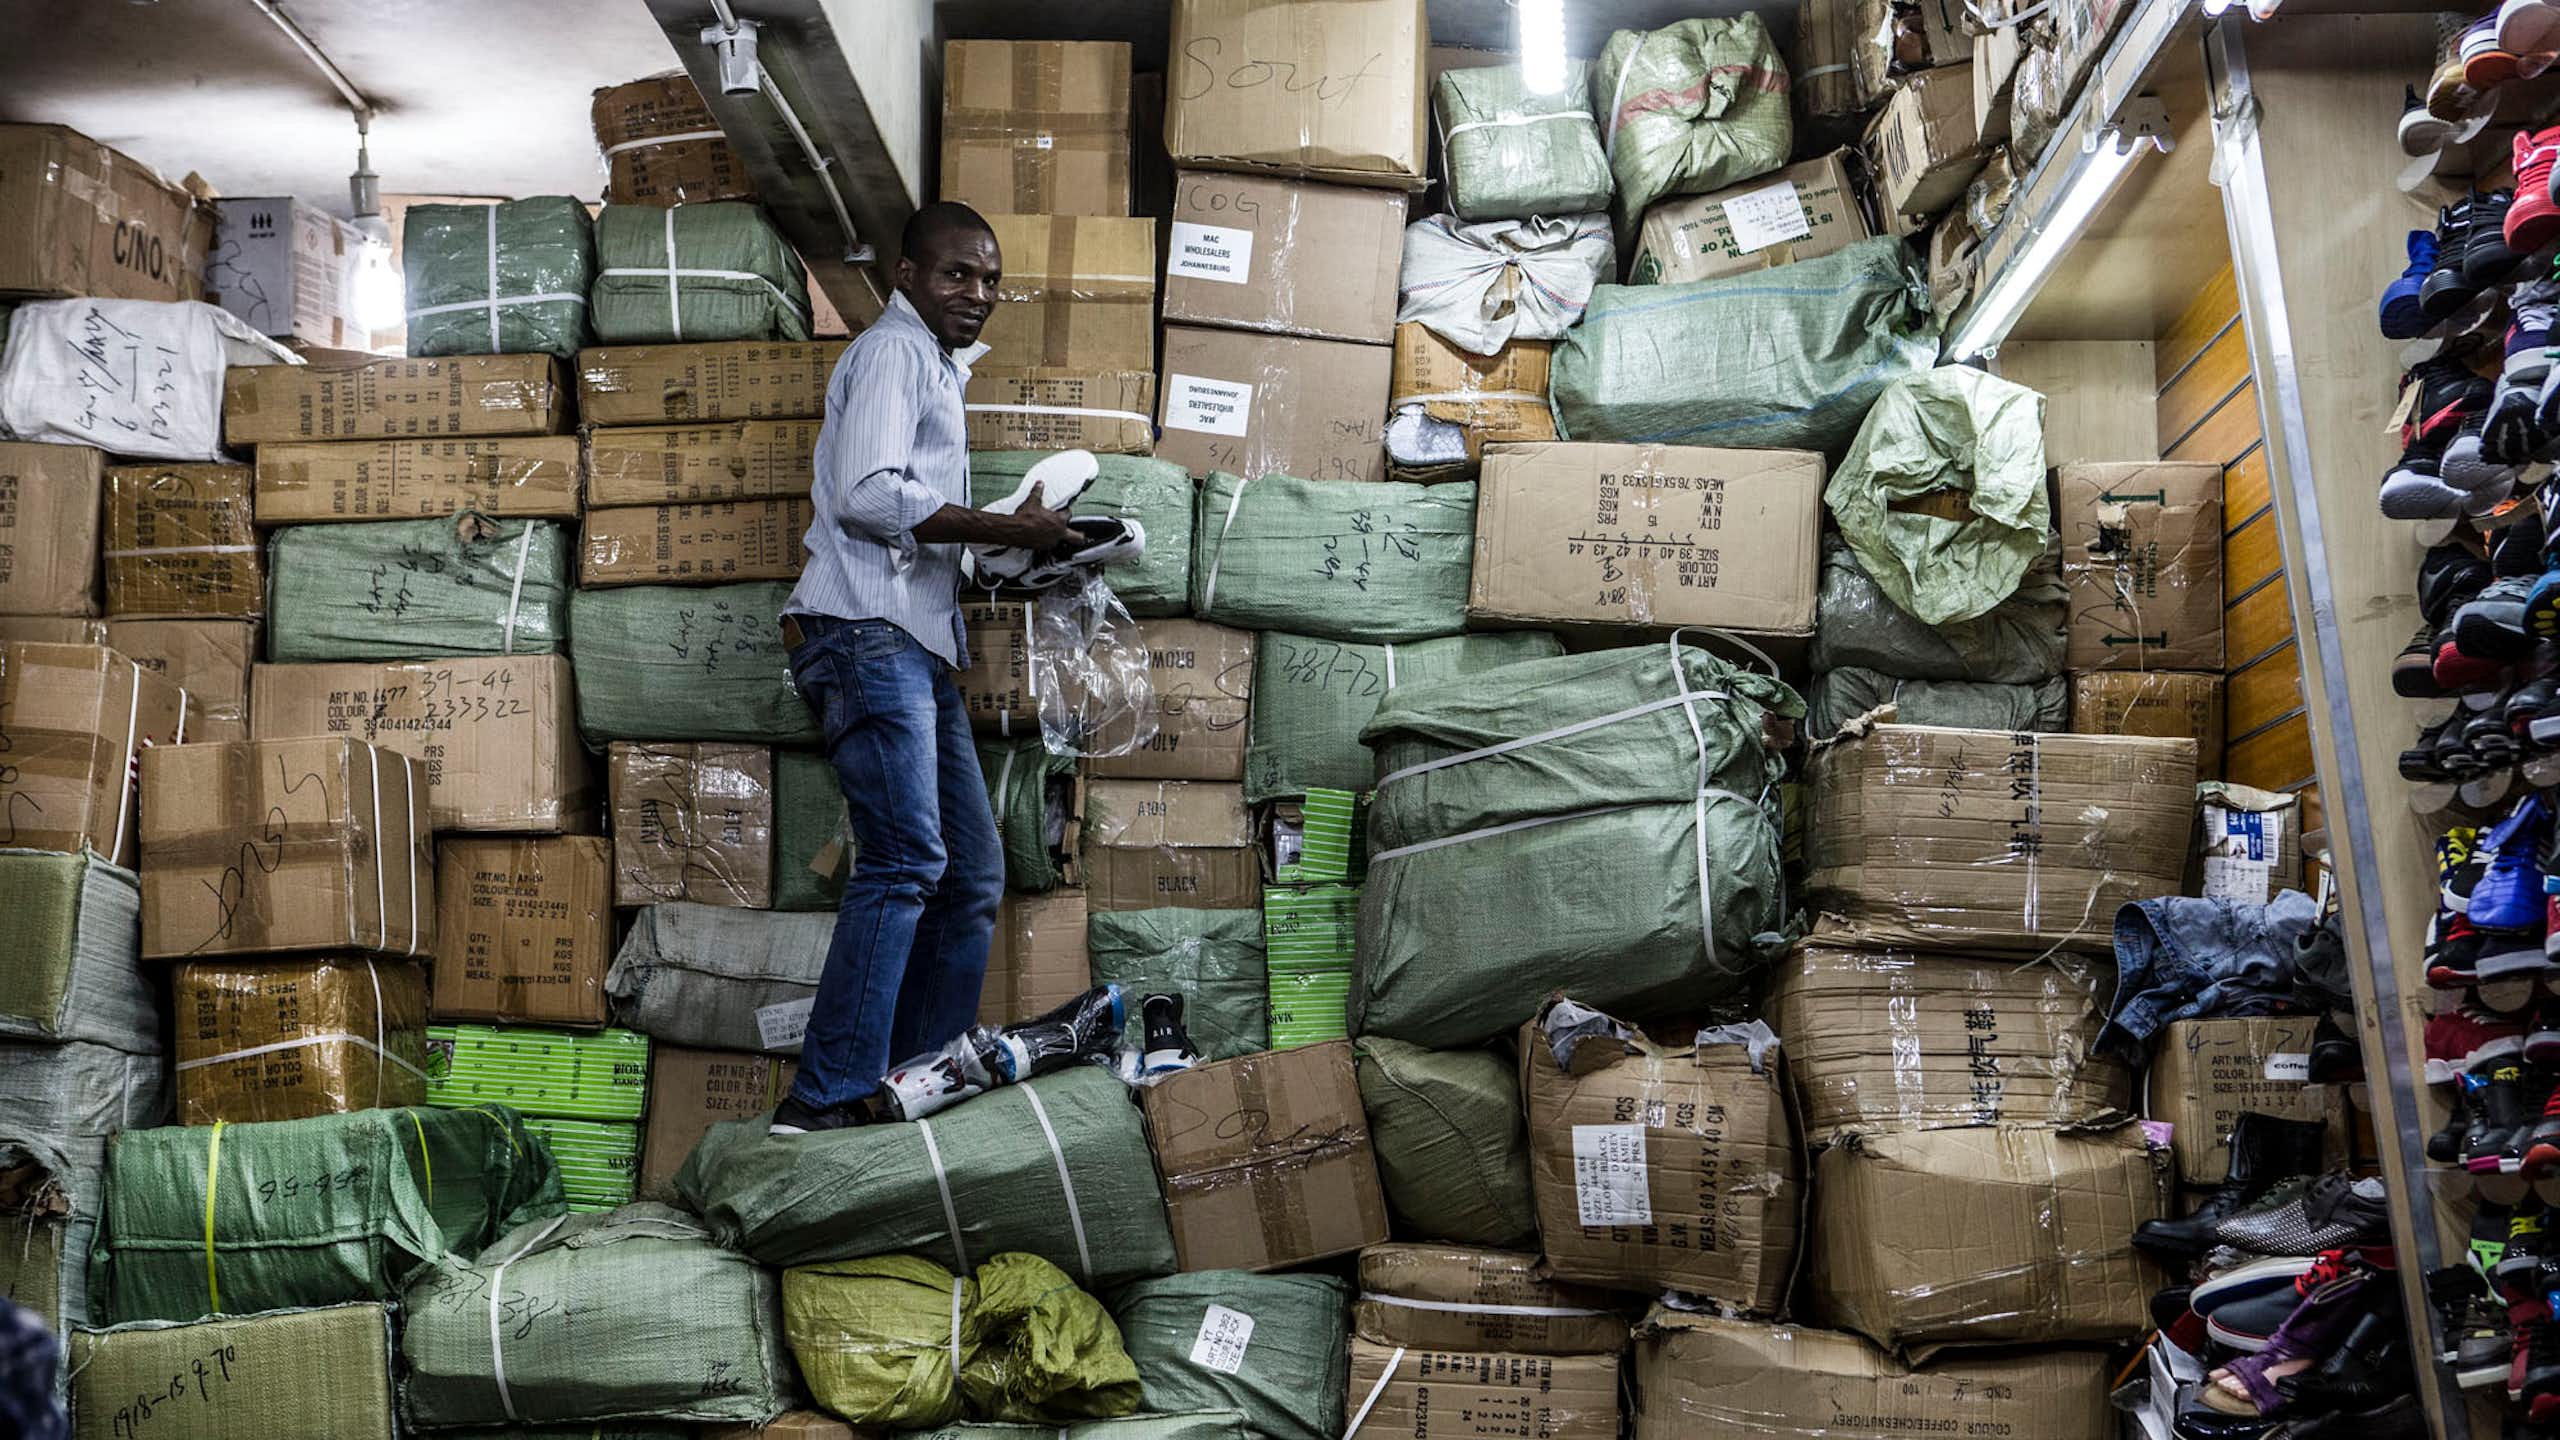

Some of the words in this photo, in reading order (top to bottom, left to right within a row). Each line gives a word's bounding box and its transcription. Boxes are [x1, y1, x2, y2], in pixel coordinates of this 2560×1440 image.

[1202, 234, 1220, 245] MAC
[1184, 244, 1231, 259] WHOLESALERS
[1180, 259, 1231, 273] JOHANNESBURG
[1188, 385, 1240, 400] JOHANNESBURG
[1188, 400, 1235, 414] WHOLESALERS
[1199, 414, 1217, 425] MAC
[1599, 473, 1616, 486] CM
[1598, 486, 1620, 499] KGS
[1598, 499, 1619, 512] KGS
[1597, 512, 1618, 526] PRS
[1648, 515, 1658, 527] 15
[1568, 542, 1586, 555] 44
[1593, 543, 1609, 557] 43
[1616, 543, 1632, 558] 42
[1638, 545, 1653, 559] 41
[1659, 546, 1676, 560] 40
[1679, 547, 1694, 560] 39
[329, 691, 351, 704] ART
[424, 745, 445, 758] PRS
[427, 759, 443, 773] GS
[427, 773, 442, 786] GS
[1137, 801, 1166, 817] A109
[1156, 876, 1199, 893] BLACK
[555, 937, 575, 948] PRS
[553, 949, 574, 960] KGS
[552, 962, 572, 972] KGS
[1152, 1026, 1173, 1039] AIR
[1612, 1097, 1637, 1123] PCS
[1673, 1103, 1697, 1129] KGS
[1706, 1106, 1726, 1126] CM
[1704, 1129, 1722, 1145] 40
[1598, 1136, 1609, 1172] BLACK
[1620, 1136, 1631, 1173] CAMEL
[1631, 1141, 1641, 1163] PRS
[1702, 1147, 1721, 1157] X
[1700, 1160, 1718, 1179] 45
[1701, 1181, 1718, 1191] X
[1699, 1194, 1716, 1211] 60
[1203, 1330, 1213, 1341] YT
[1510, 1358, 1522, 1387] BLACK
[1461, 1408, 1472, 1422] 24
